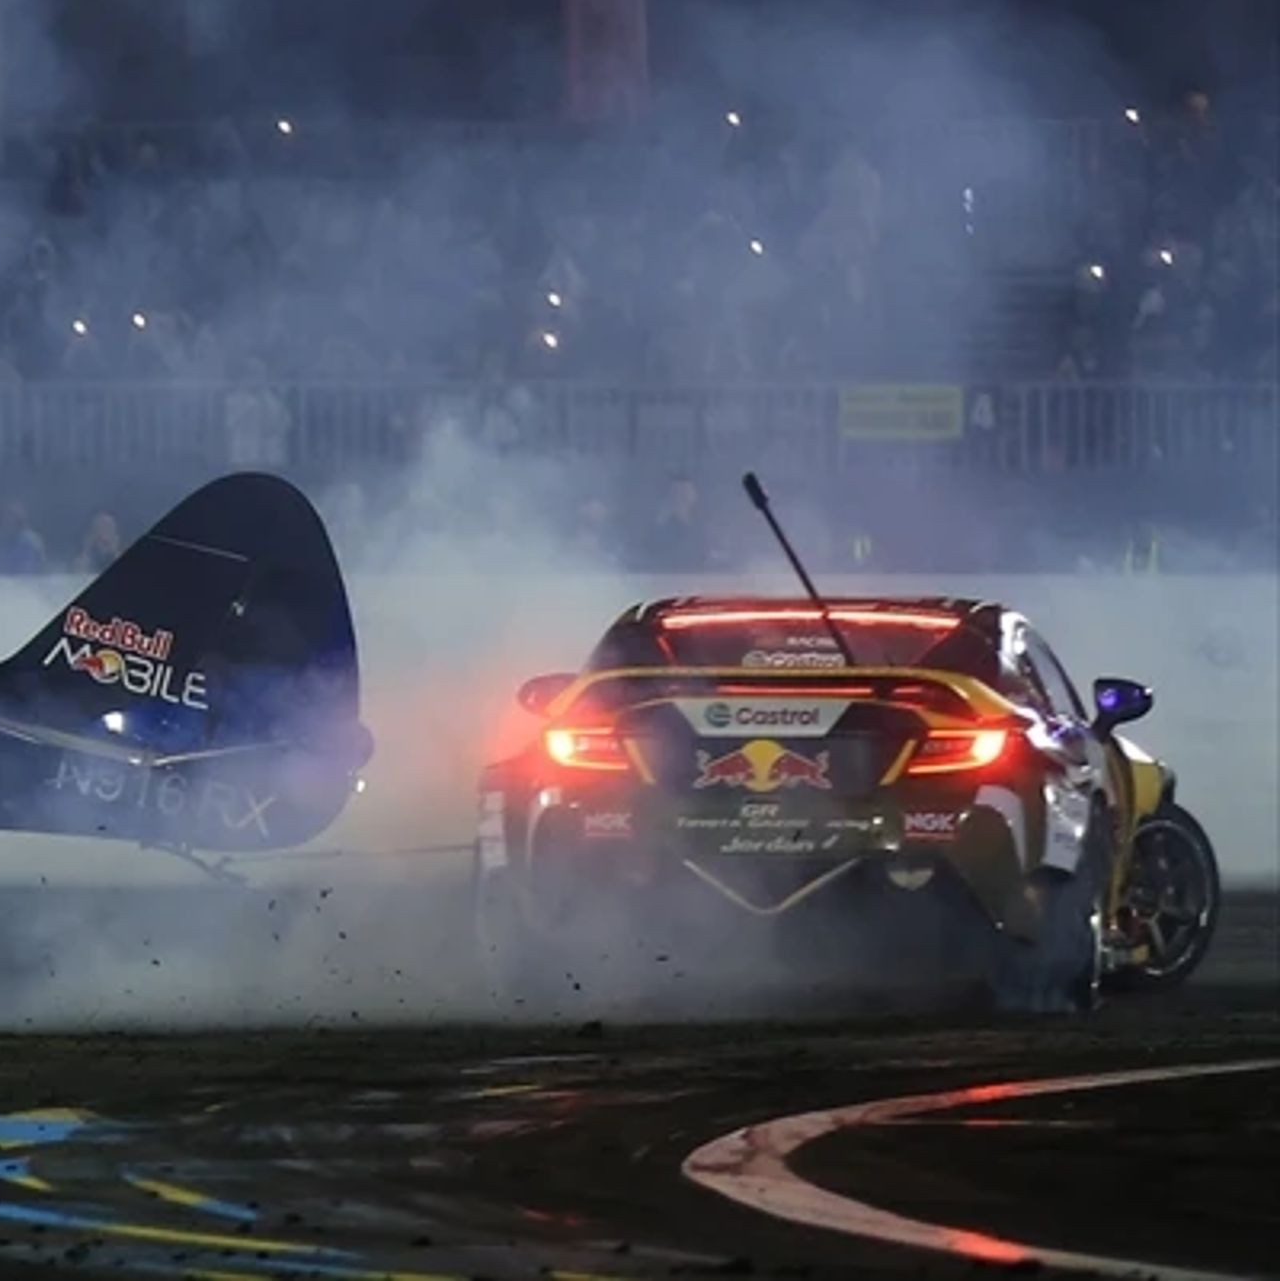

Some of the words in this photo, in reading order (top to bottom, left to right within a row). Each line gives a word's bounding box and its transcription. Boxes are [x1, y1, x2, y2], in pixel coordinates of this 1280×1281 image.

[64, 606, 119, 646] Red
[119, 617, 174, 660] Bull
[43, 636, 209, 710] MOBILE
[735, 706, 820, 726] Castrol
[904, 812, 957, 831] NGK
